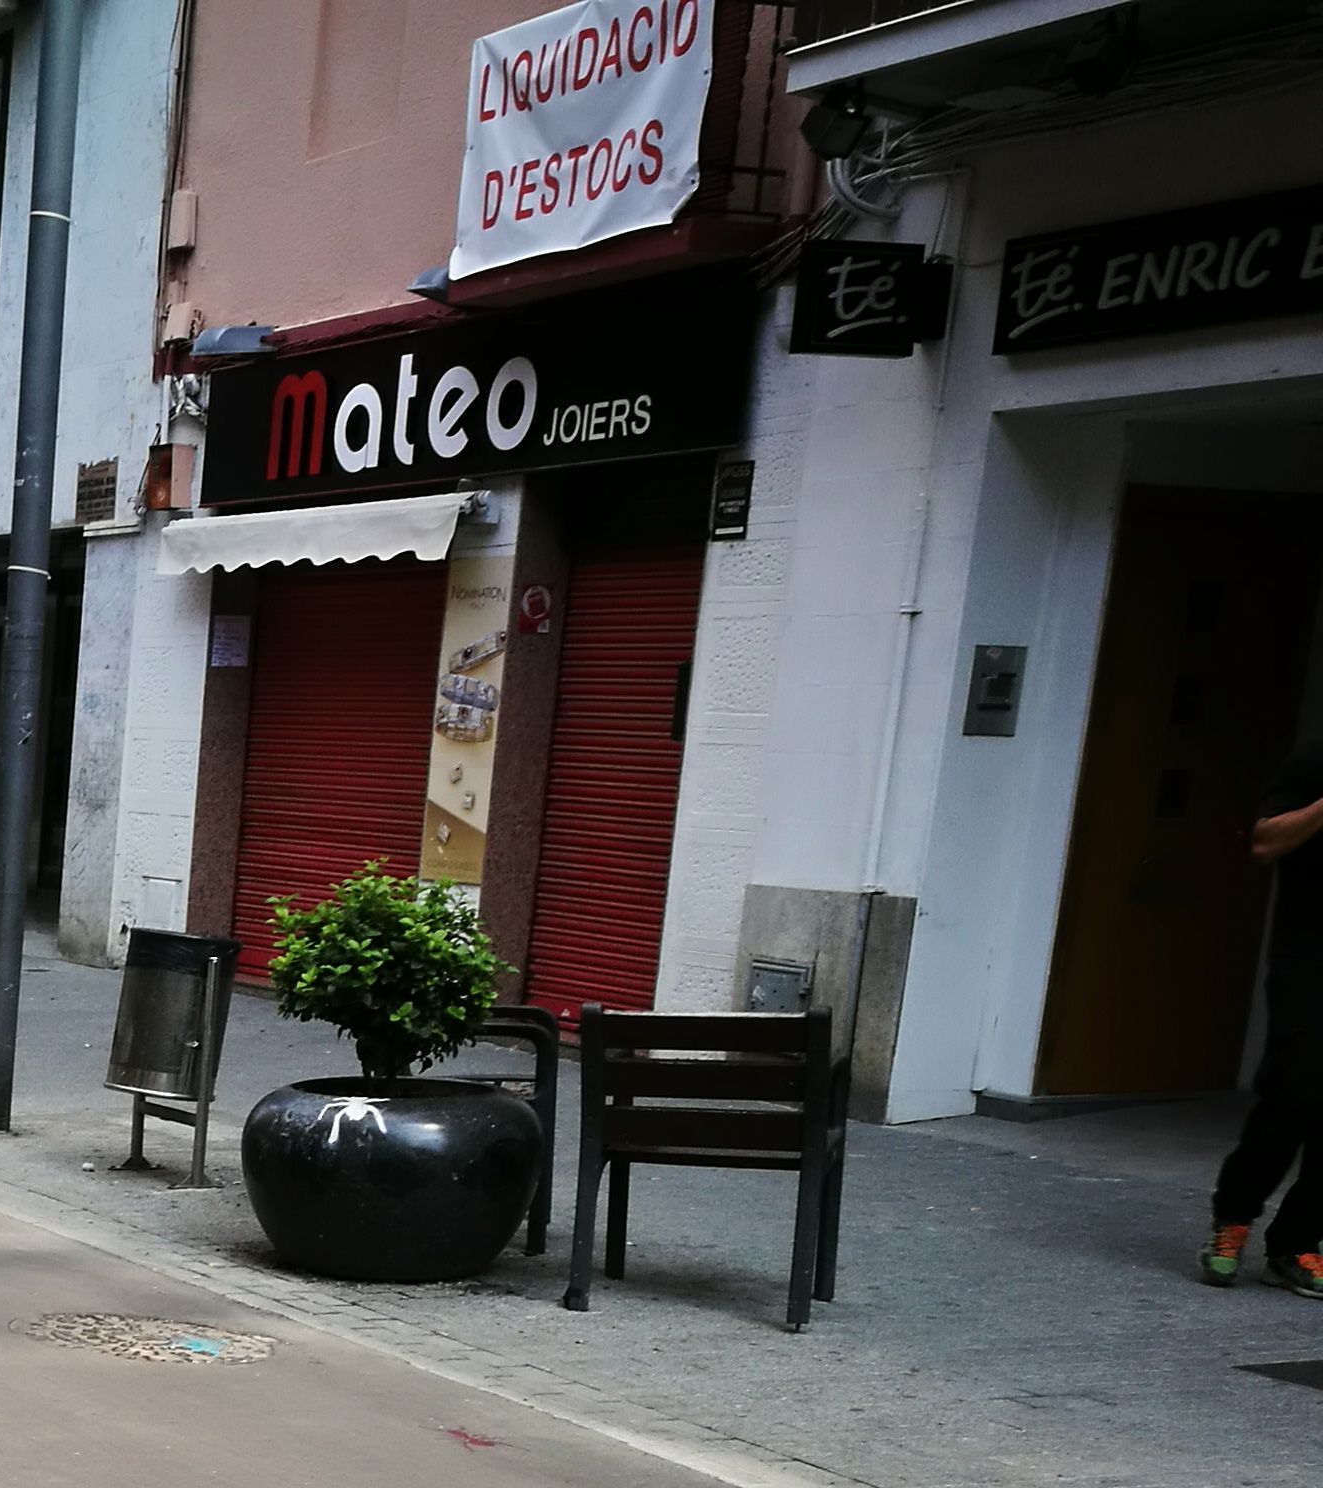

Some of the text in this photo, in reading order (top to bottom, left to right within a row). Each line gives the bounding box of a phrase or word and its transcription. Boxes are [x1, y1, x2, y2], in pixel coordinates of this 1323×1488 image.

[481, 118, 664, 230] D'ESTOCS
[1097, 225, 1284, 311] ENRIC
[267, 354, 653, 481] mateo JOIERS
